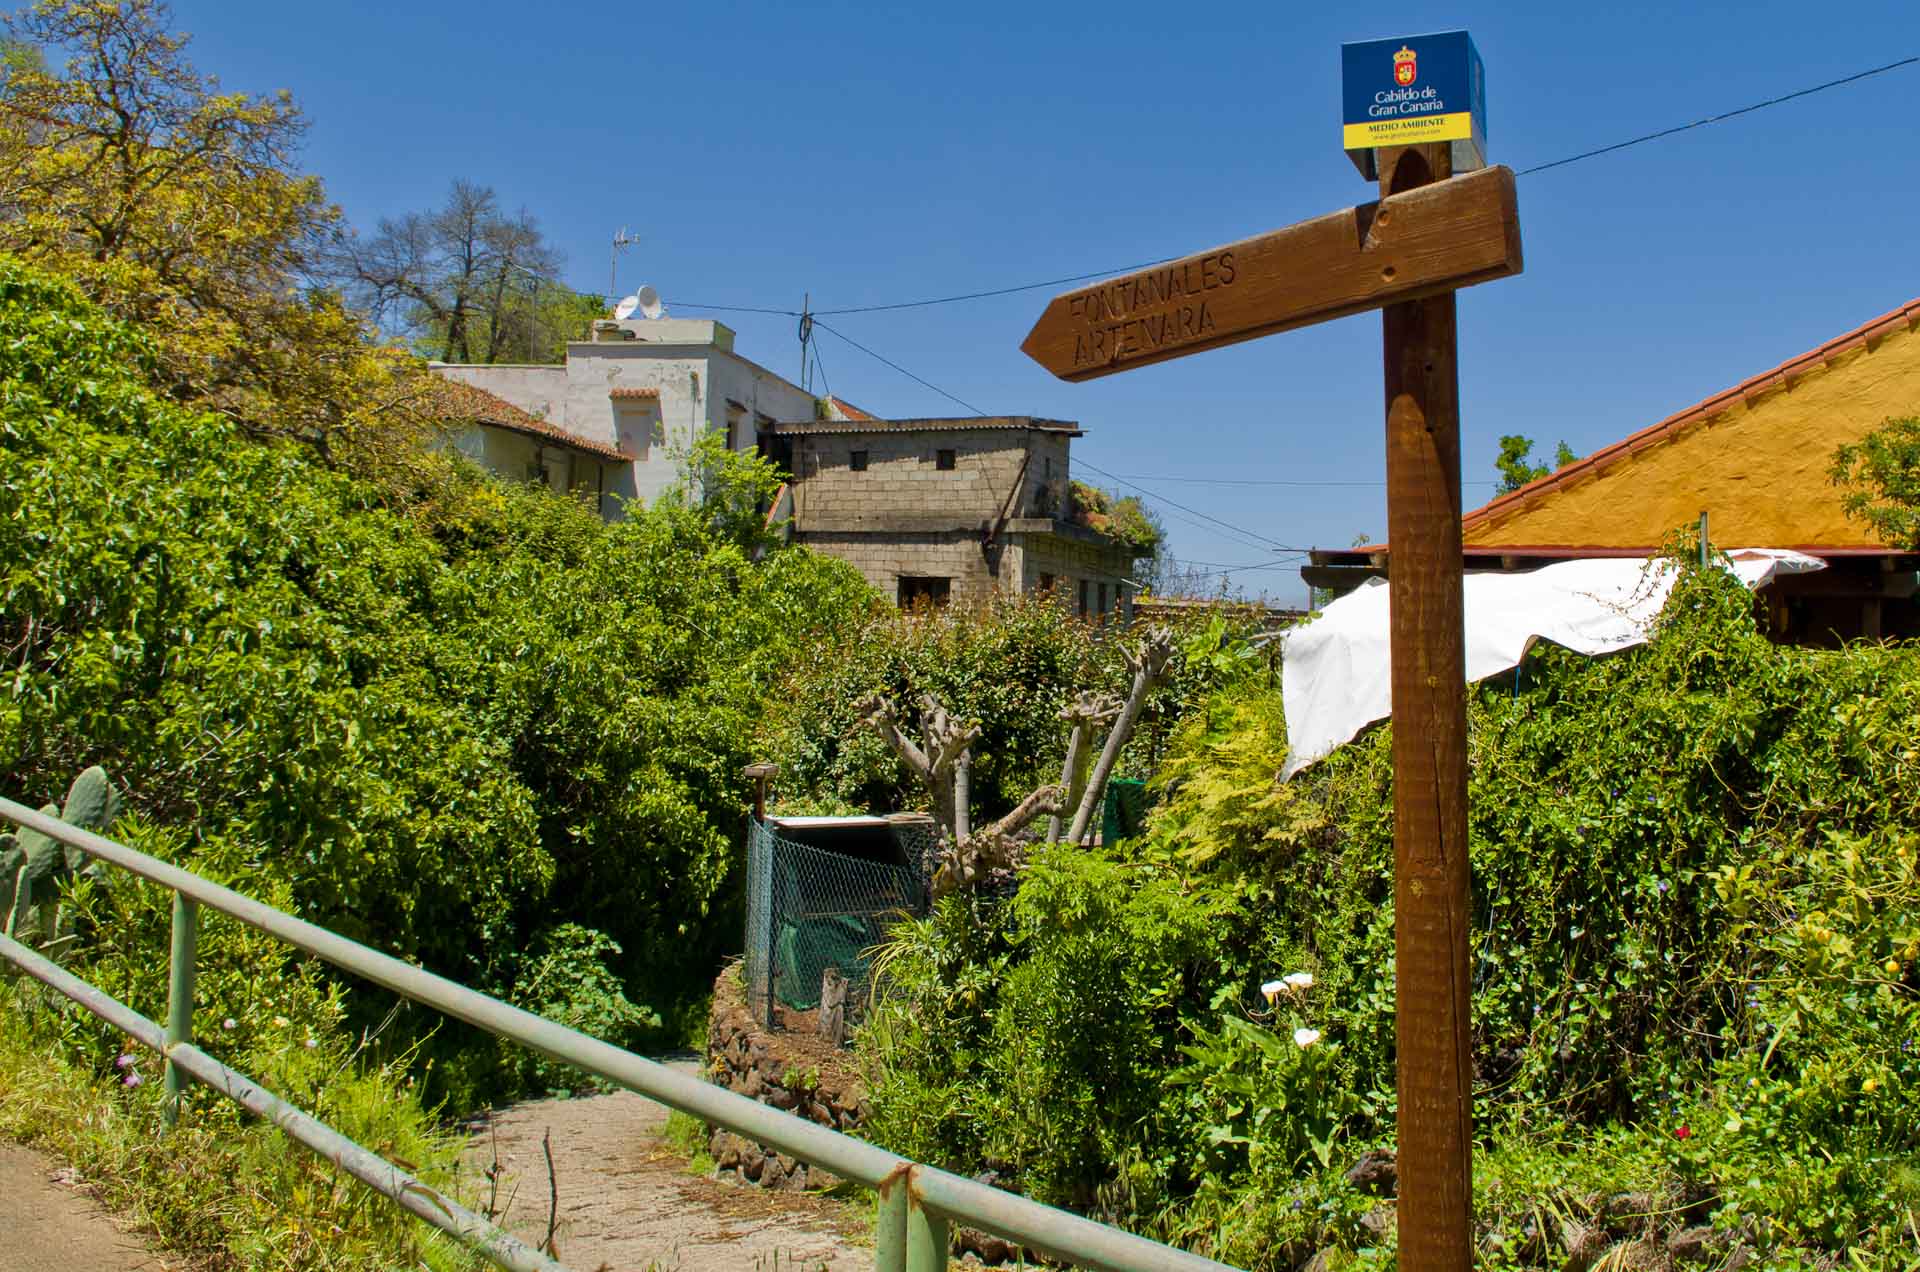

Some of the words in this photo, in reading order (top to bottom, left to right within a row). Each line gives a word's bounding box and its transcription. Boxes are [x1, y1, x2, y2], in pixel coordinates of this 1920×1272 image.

[1375, 88, 1419, 104] Cabildo
[1421, 86, 1437, 98] de
[1368, 104, 1397, 117] Gran
[1399, 99, 1444, 113] Canaria
[1368, 123, 1399, 133] MEDIO
[1400, 118, 1445, 129] AMBIENTE
[1070, 252, 1236, 328] FONTANALES
[1074, 302, 1216, 366] ARTENARA
